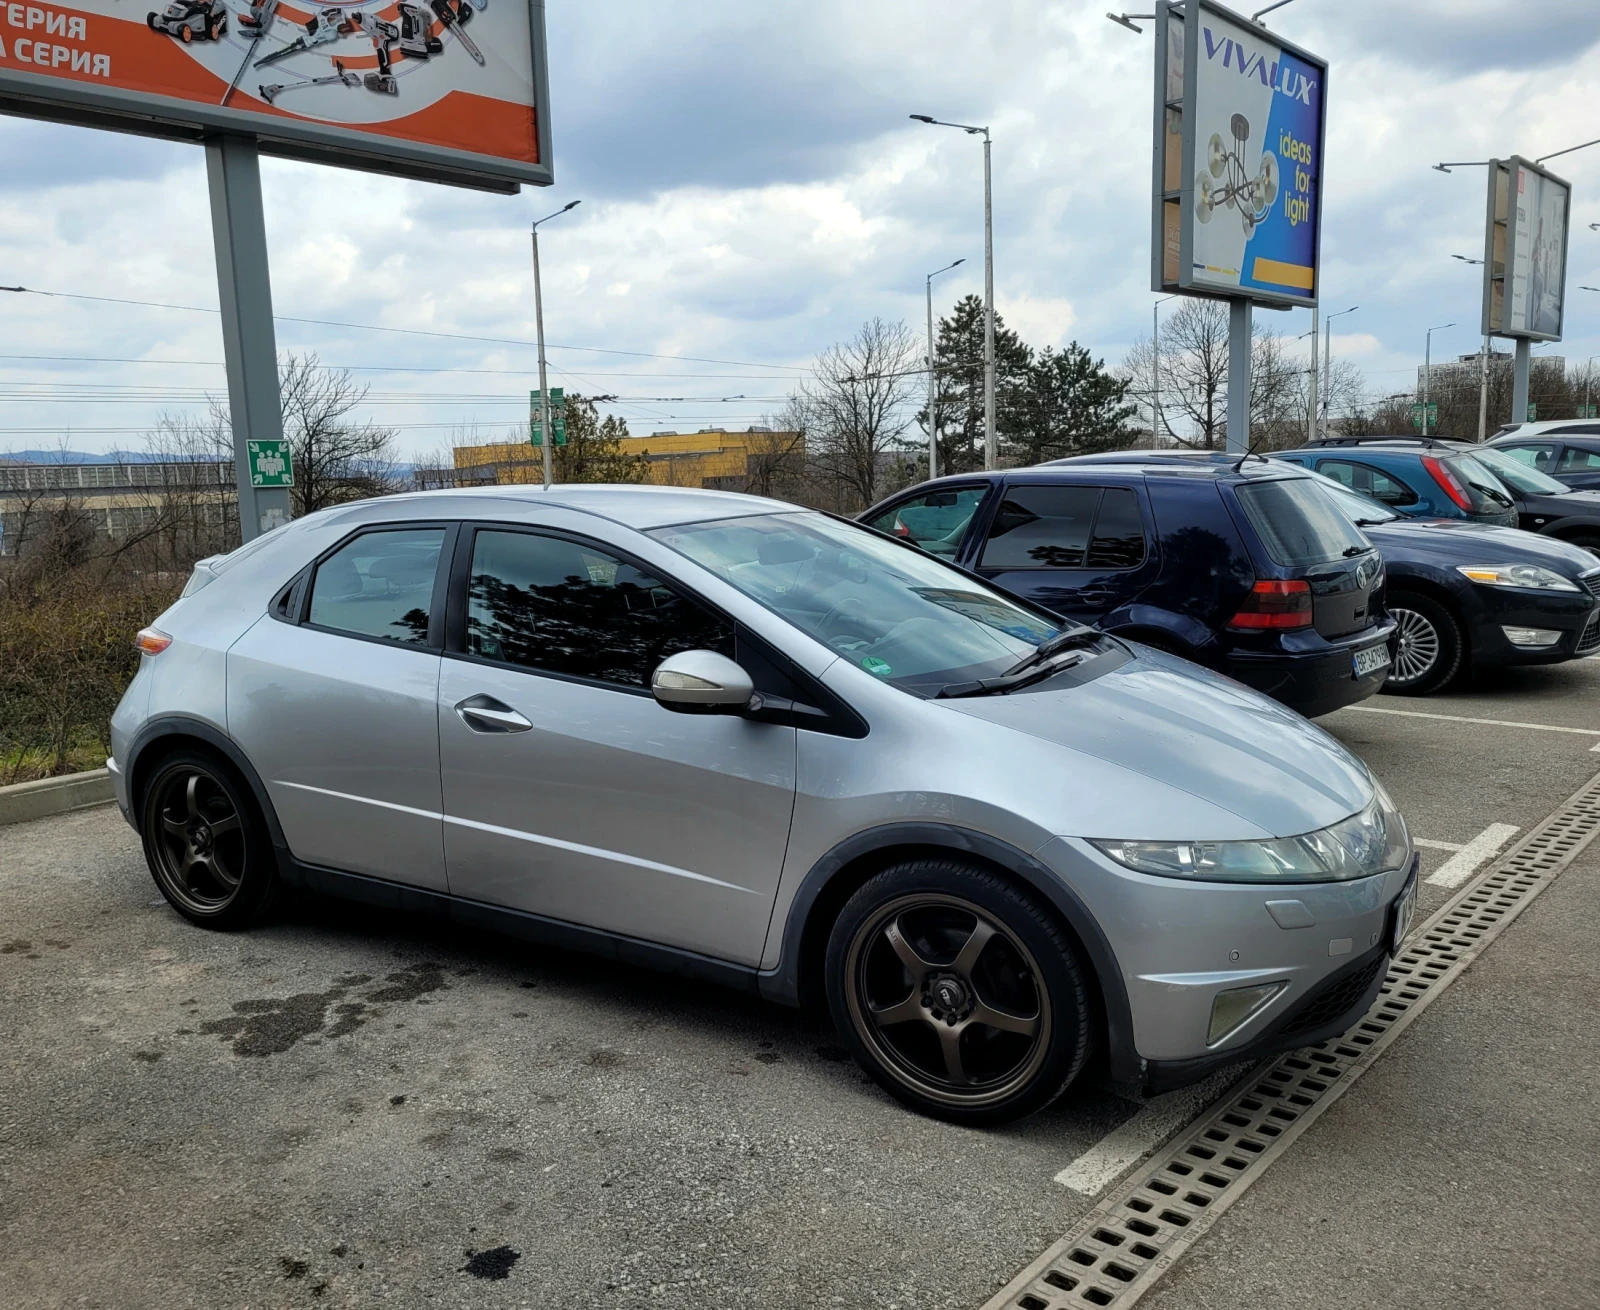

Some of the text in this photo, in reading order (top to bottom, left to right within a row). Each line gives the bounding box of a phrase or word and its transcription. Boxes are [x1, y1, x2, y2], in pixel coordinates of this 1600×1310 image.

[14, 38, 111, 78] СЕРИЯ
[1203, 27, 1310, 106] VIVALUX
[1280, 128, 1312, 166] ideas
[1295, 164, 1311, 194] for
[1284, 190, 1310, 227] light
